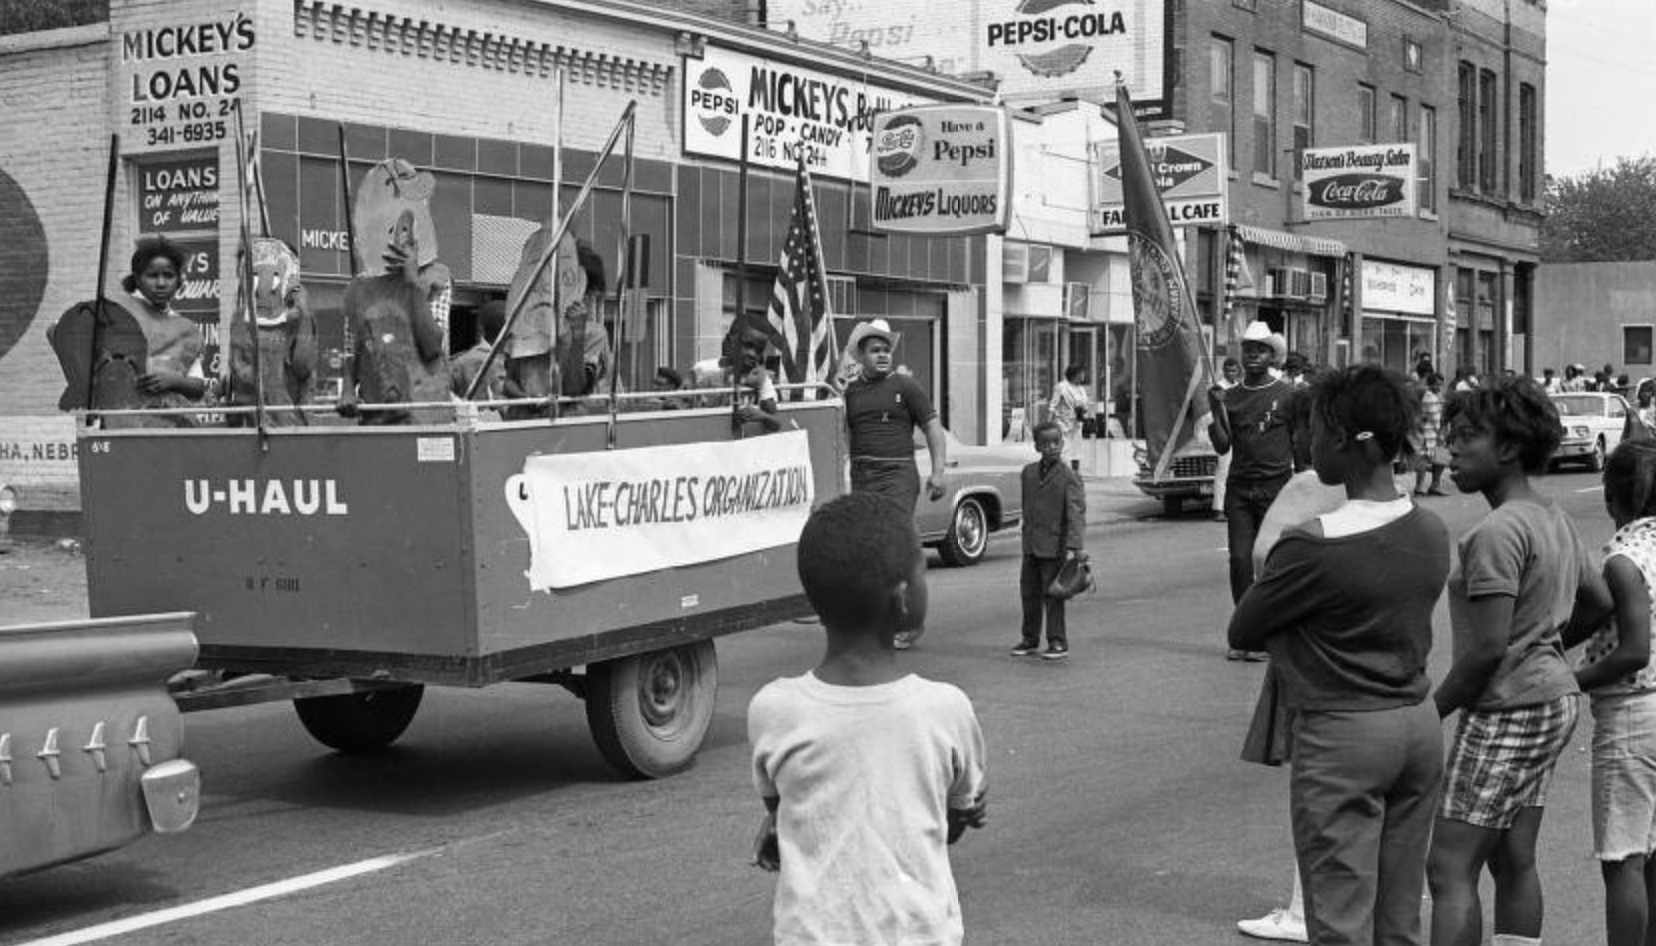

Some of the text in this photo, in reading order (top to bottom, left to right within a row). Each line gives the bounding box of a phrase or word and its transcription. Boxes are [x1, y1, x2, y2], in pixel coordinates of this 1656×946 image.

[123, 12, 255, 62] MICKEY'S
[133, 63, 241, 102] LOANS
[131, 106, 166, 125] 2114
[179, 102, 211, 121] NO.
[691, 90, 739, 115] PEPSI
[147, 121, 227, 146] 341-6935
[754, 113, 785, 136] POP
[799, 123, 843, 148] CANDY
[941, 120, 985, 134] Have a
[753, 136, 776, 159] 2116
[932, 138, 995, 167] Pepsi
[144, 166, 217, 192] LOANS
[1322, 179, 1388, 203] Coca-Cola
[144, 194, 163, 209] ON
[937, 187, 997, 219] LIQUORS
[1182, 203, 1220, 220] CAFE
[152, 211, 171, 226] OF
[301, 229, 350, 251] MICKE
[184, 478, 349, 516] U-HAUL
[563, 465, 808, 531] LAKE-CHARLES ORGANIZATION
